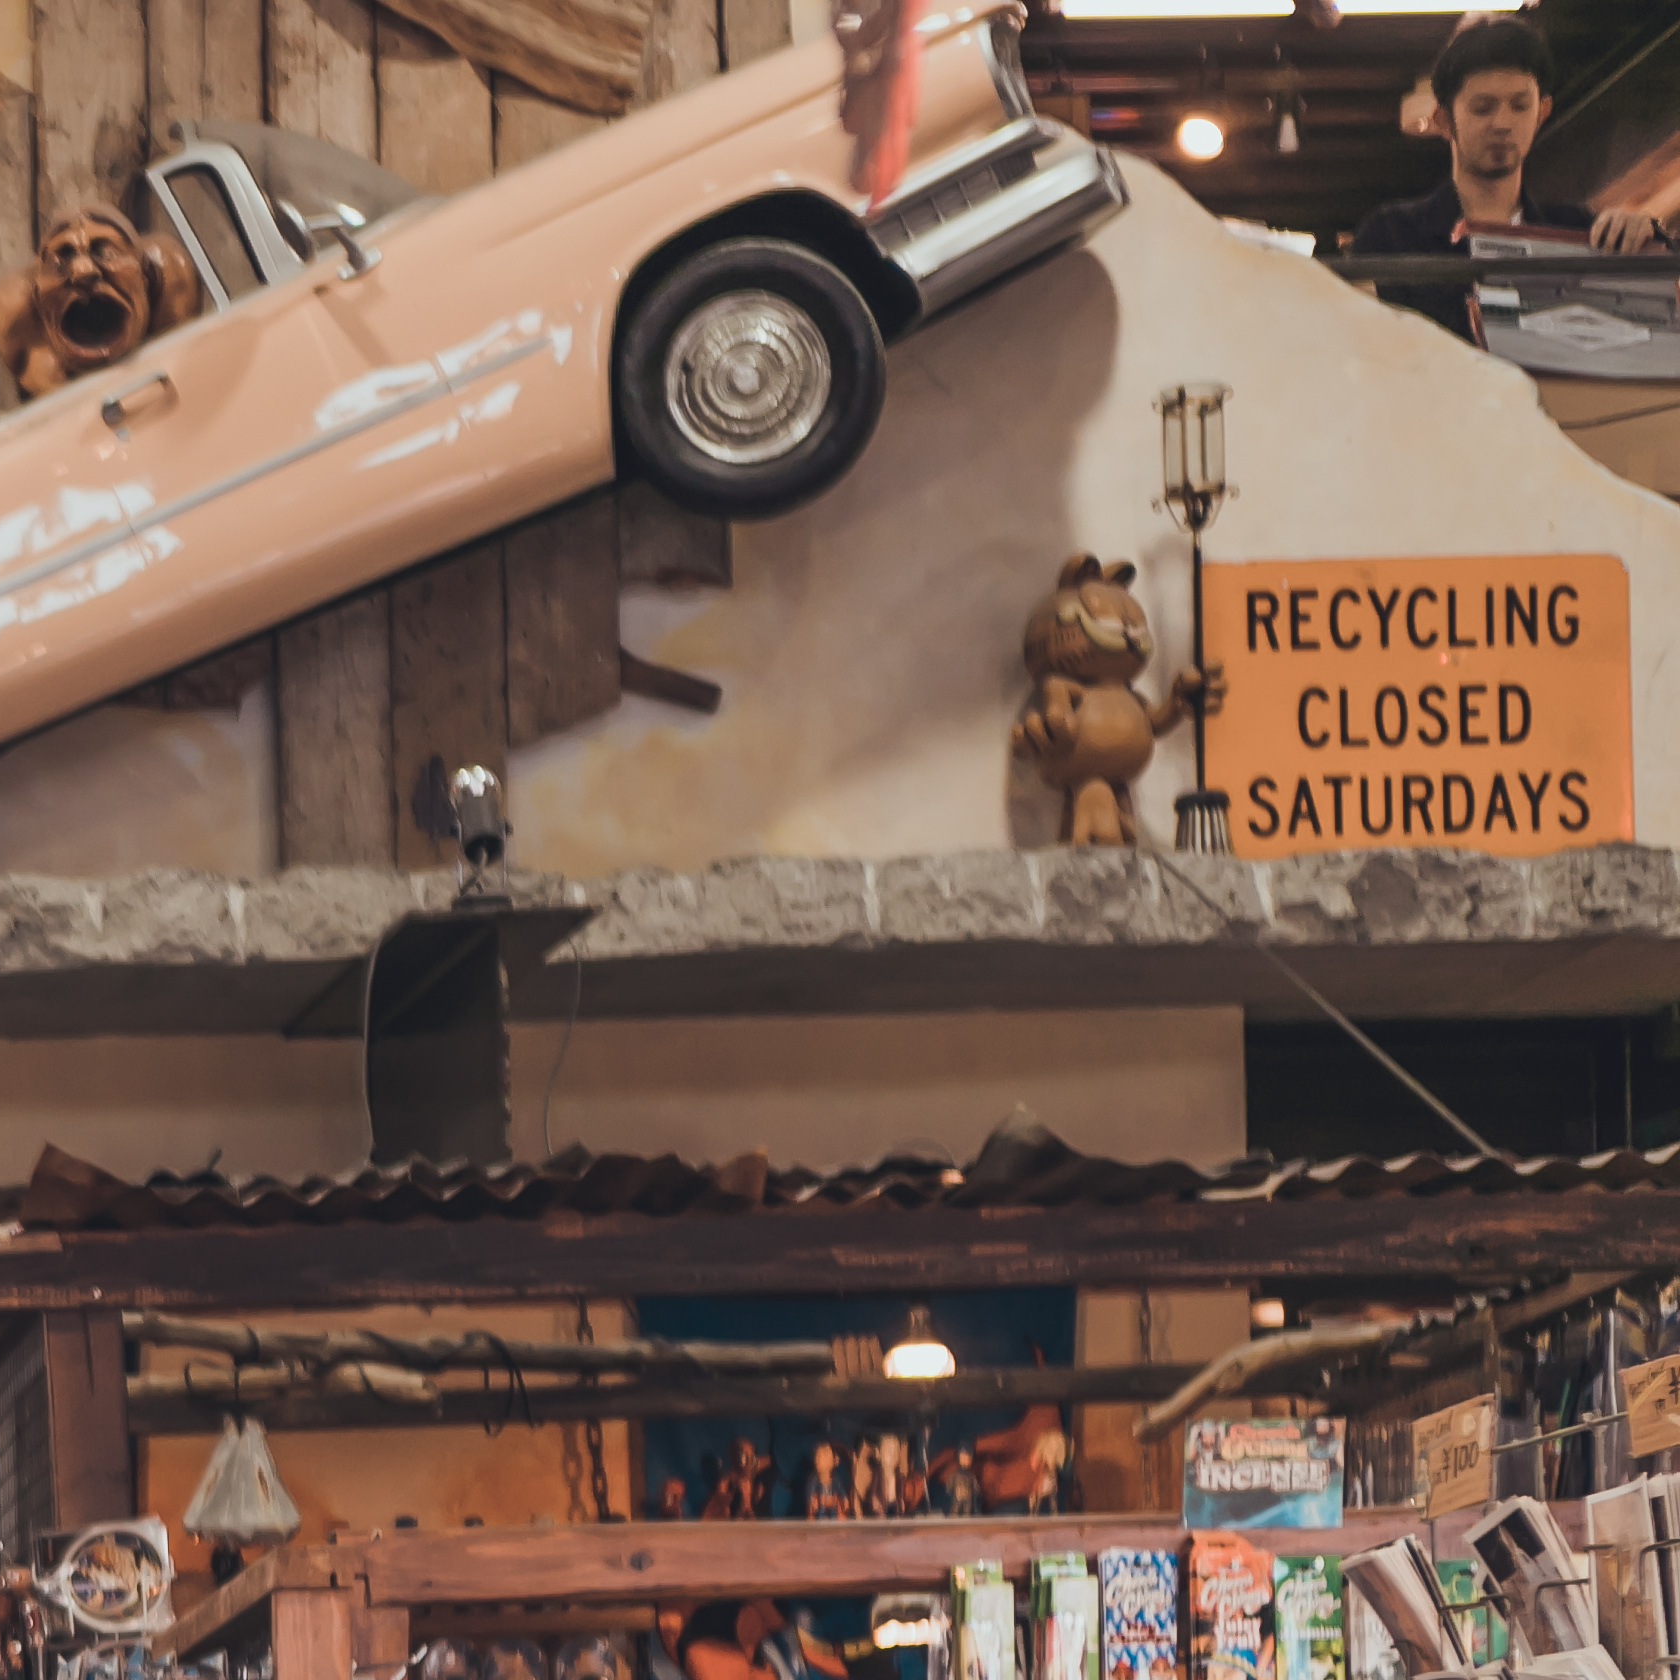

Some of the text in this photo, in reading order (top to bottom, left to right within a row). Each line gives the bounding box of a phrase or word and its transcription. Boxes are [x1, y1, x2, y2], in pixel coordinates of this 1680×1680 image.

[1245, 583, 1581, 653] RECYCLING
[1296, 682, 1534, 749] CLOSED
[1246, 768, 1592, 839] SATURDAYS
